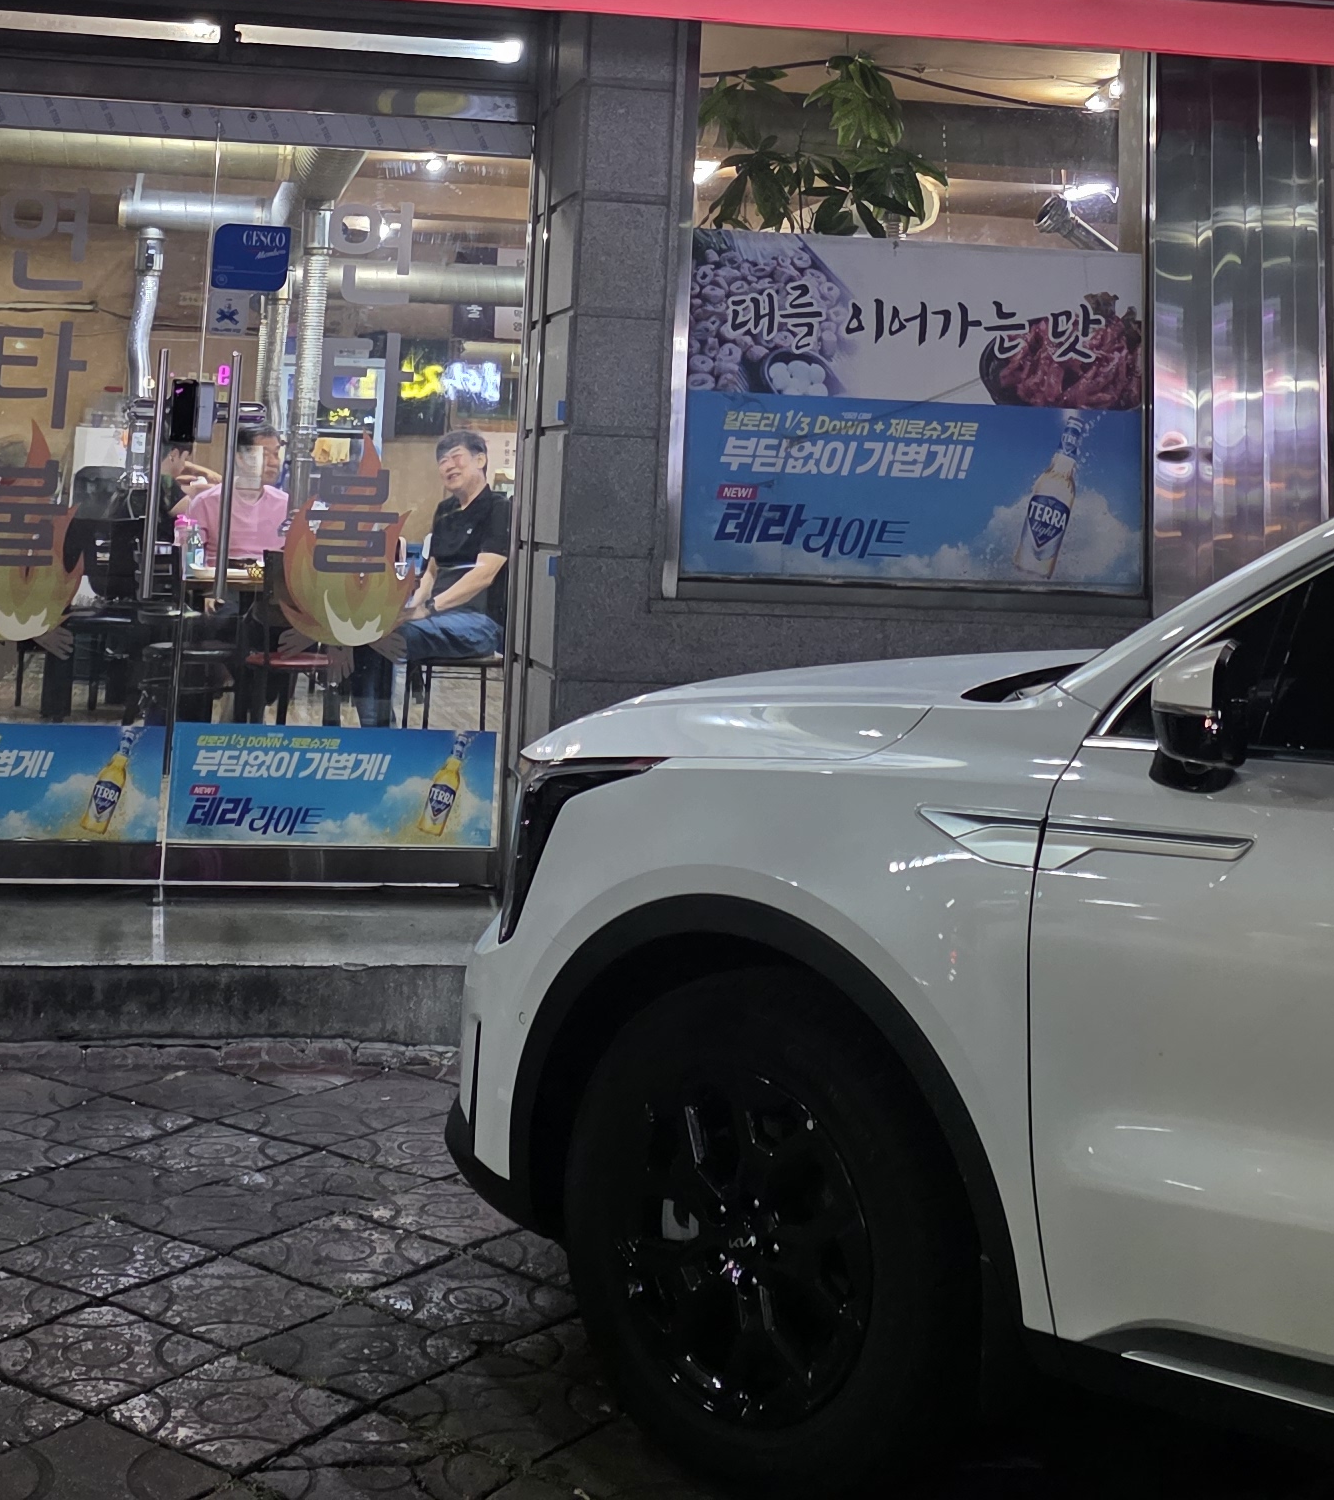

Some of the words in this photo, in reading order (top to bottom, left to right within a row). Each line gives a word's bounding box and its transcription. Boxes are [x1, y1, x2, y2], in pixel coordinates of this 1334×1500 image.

[242, 229, 286, 248] CESCO
[728, 282, 823, 353] 대를
[844, 298, 1027, 363] 이어가는
[1048, 305, 1107, 363] 맛
[722, 410, 781, 433] 칼로리
[814, 416, 870, 436] Down
[887, 419, 979, 441] 제로슈거로
[720, 436, 857, 477] 부담없이
[856, 441, 975, 480] 가볍게!
[723, 486, 754, 499] NEW!
[1028, 500, 1067, 530] TERRA
[714, 502, 807, 545] 테라
[801, 514, 912, 560] 라이트
[191, 749, 297, 779] 부담없이
[298, 752, 391, 781] 가볍게!
[93, 784, 120, 803] TERRA
[430, 785, 456, 806] TERRA
